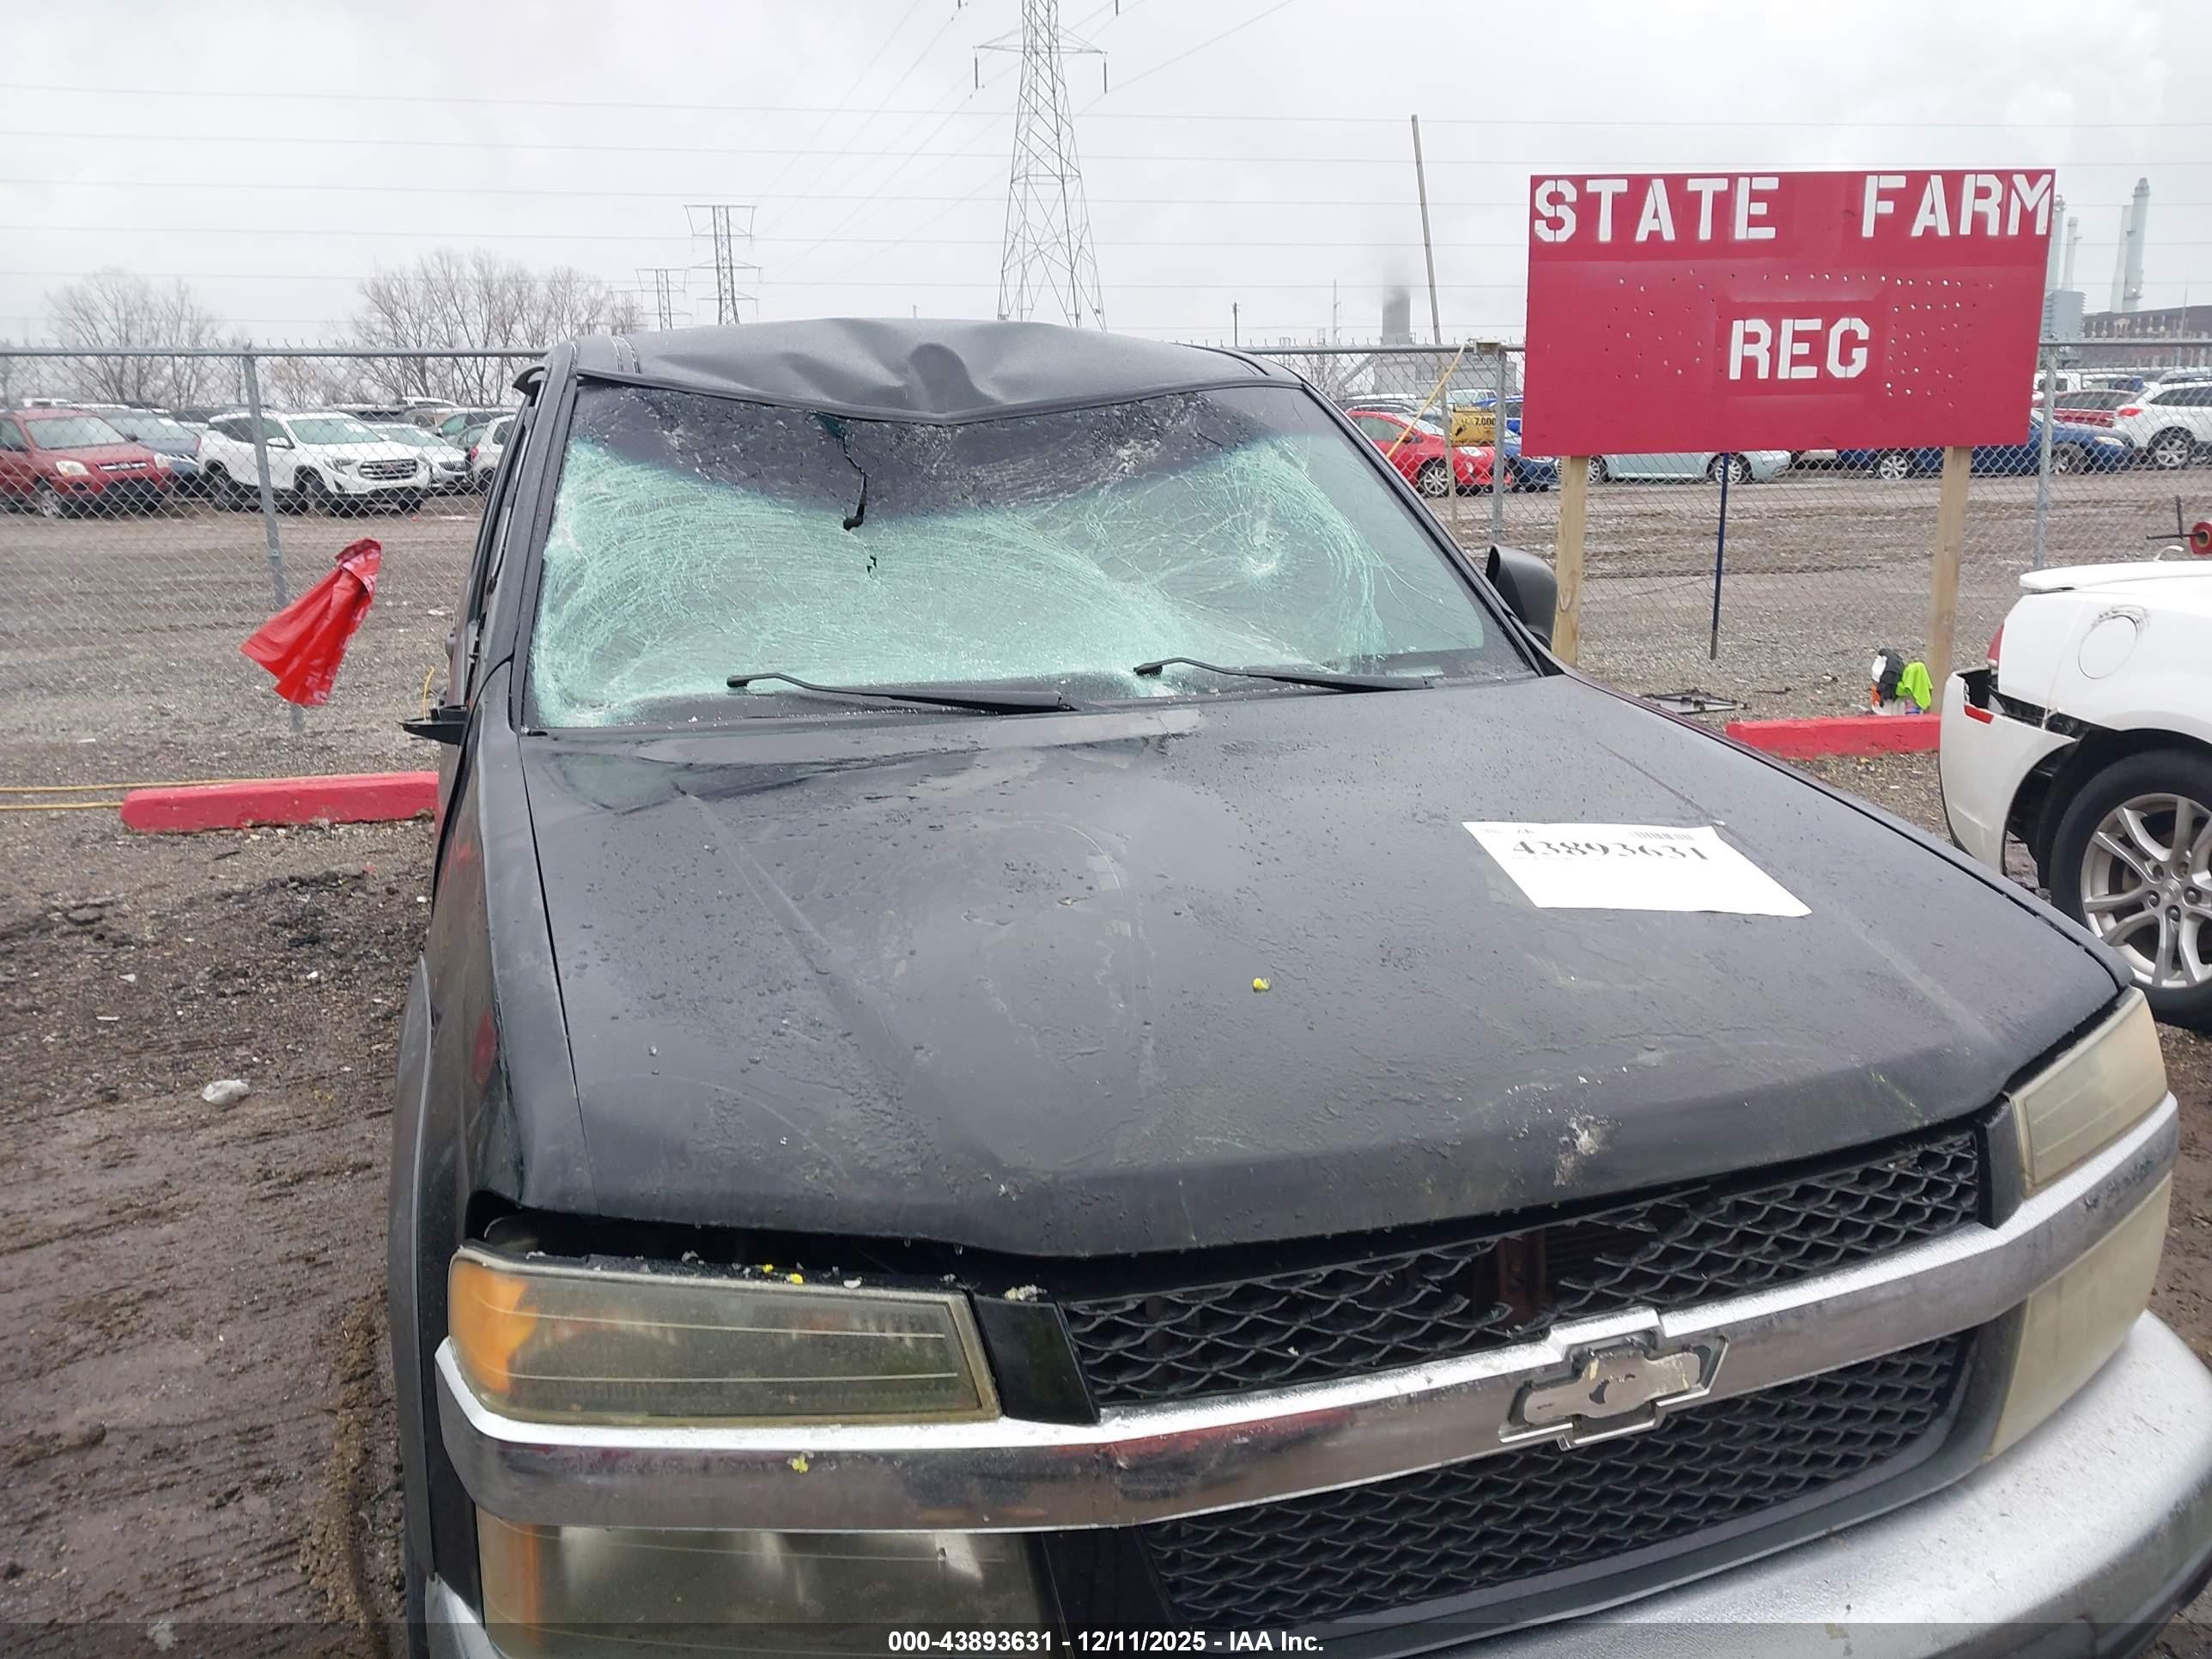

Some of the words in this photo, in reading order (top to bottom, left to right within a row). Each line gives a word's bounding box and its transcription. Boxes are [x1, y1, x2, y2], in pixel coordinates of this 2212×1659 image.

[1534, 177, 1779, 241] STATE
[1862, 173, 2052, 237] FARM
[1729, 318, 1869, 380] REG
[1513, 841, 1708, 860] 43893631
